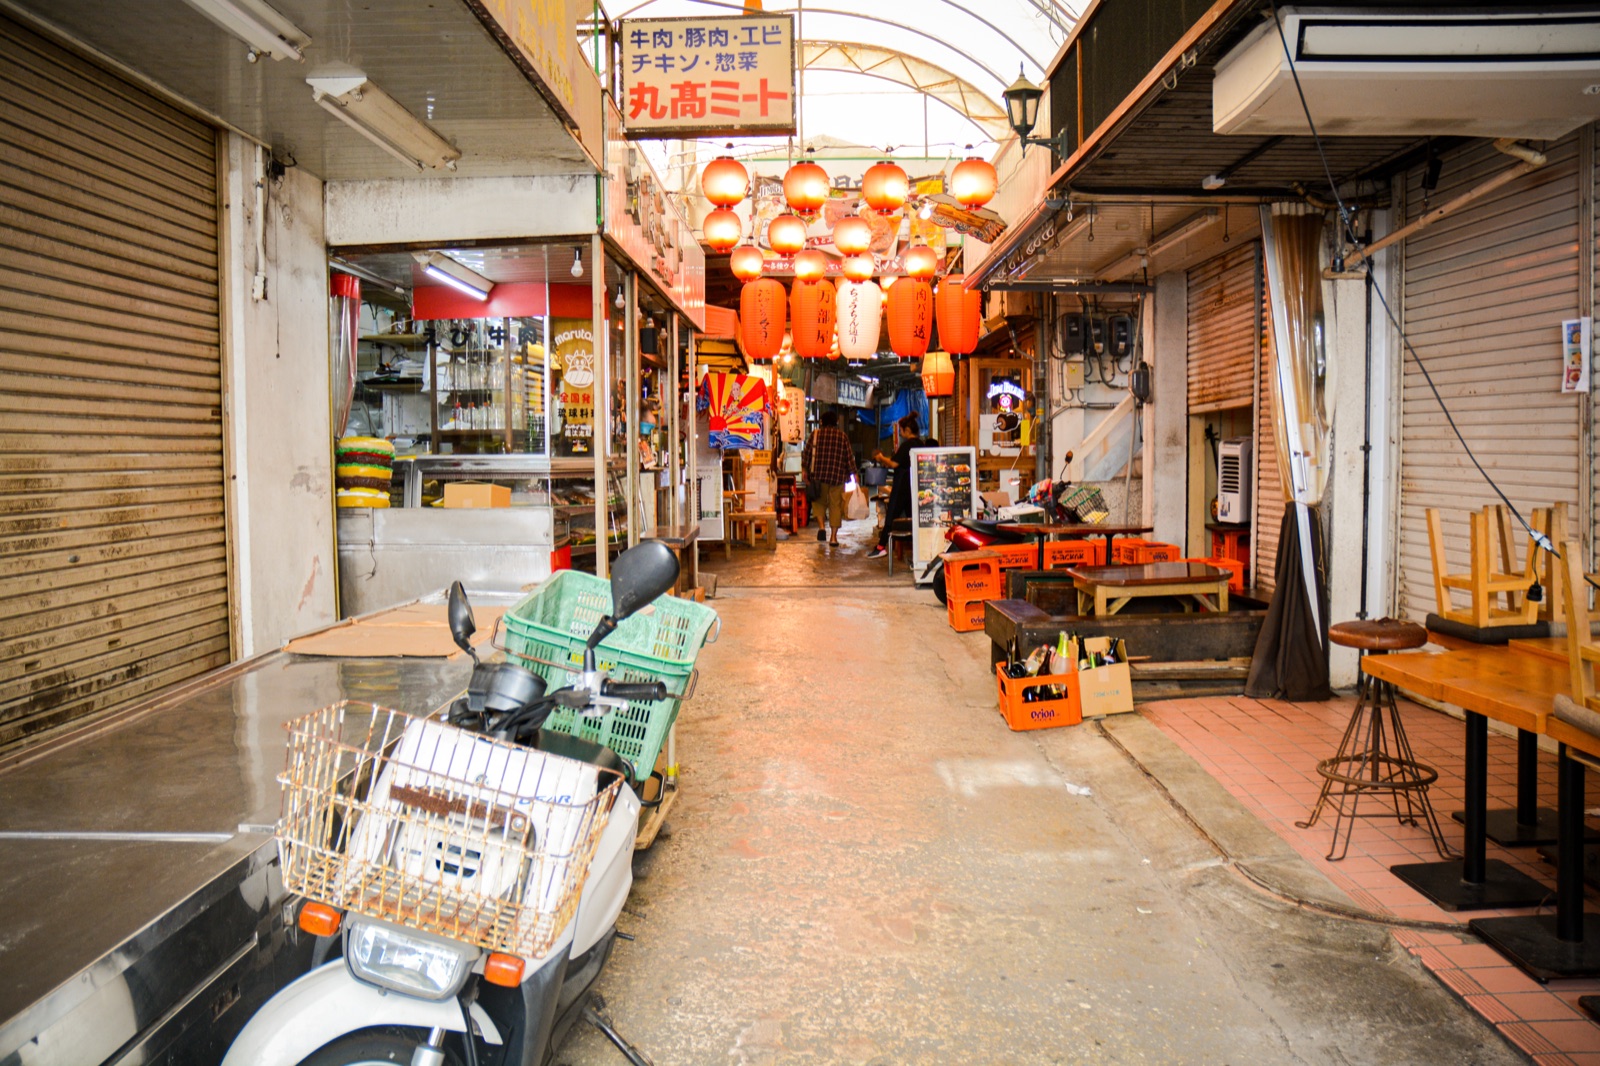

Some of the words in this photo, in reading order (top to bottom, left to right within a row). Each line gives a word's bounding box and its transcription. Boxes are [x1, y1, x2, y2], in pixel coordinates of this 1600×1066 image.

[630, 25, 782, 49] 牛肉・豚肉・エビ
[631, 51, 758, 74] チキン・惣菜
[559, 392, 595, 404] 全国発
[557, 407, 595, 419] 琉球料
